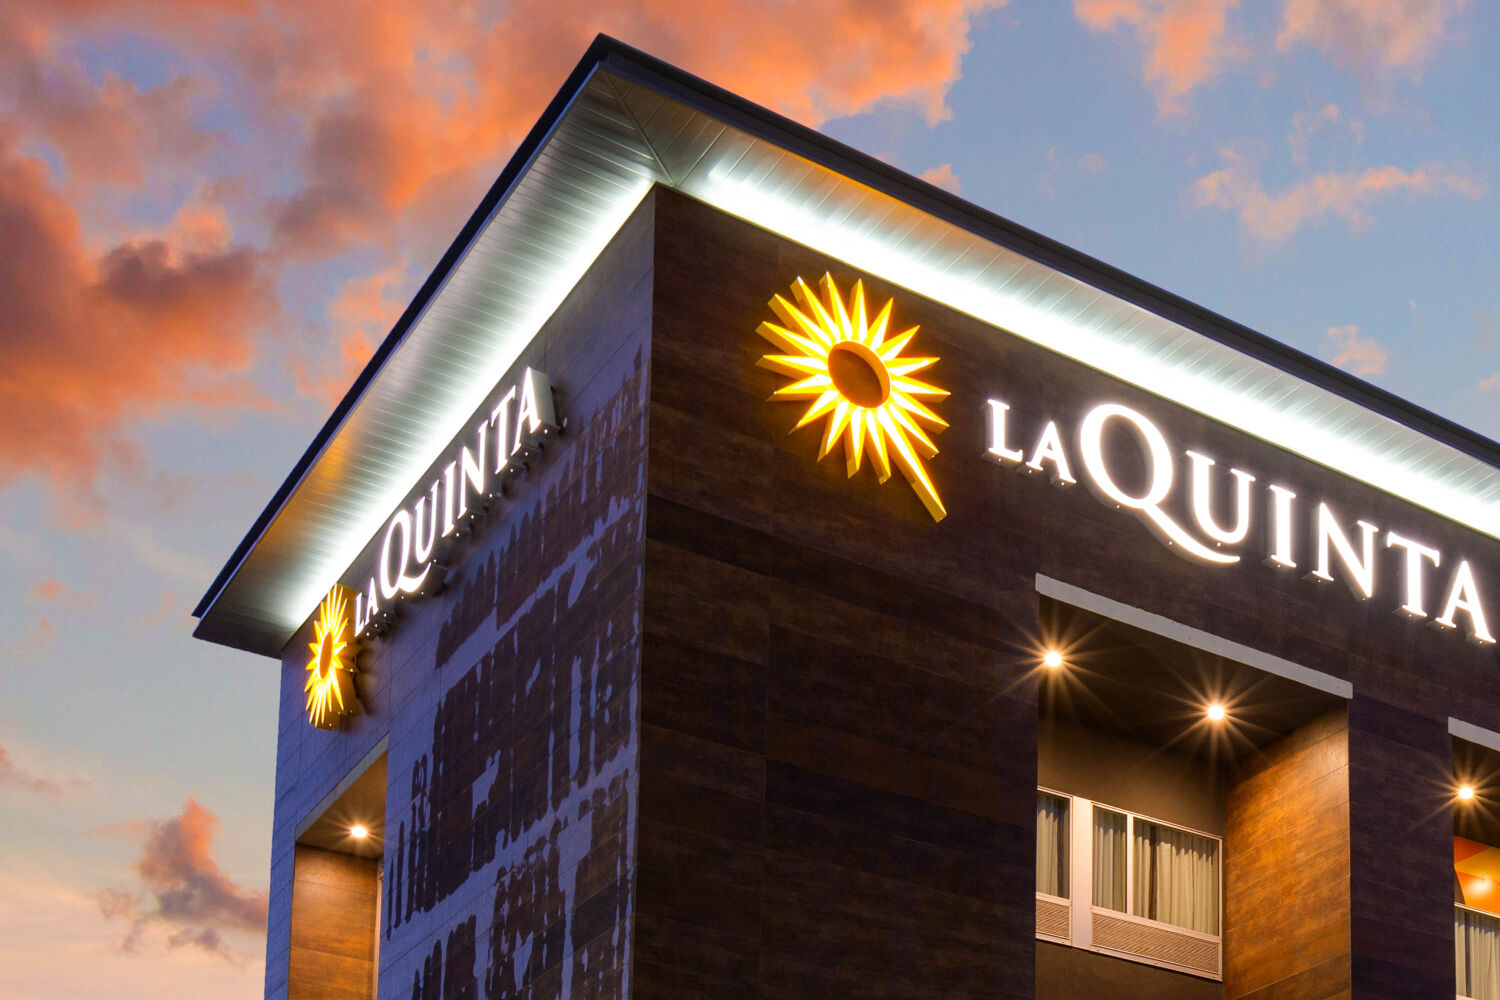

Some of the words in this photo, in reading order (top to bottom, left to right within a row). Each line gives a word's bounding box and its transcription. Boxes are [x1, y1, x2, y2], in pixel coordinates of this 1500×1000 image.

[354, 576, 379, 637] LA
[380, 366, 541, 600] QUINTA
[986, 398, 1077, 486] LA
[1079, 402, 1497, 645] QUINTA
